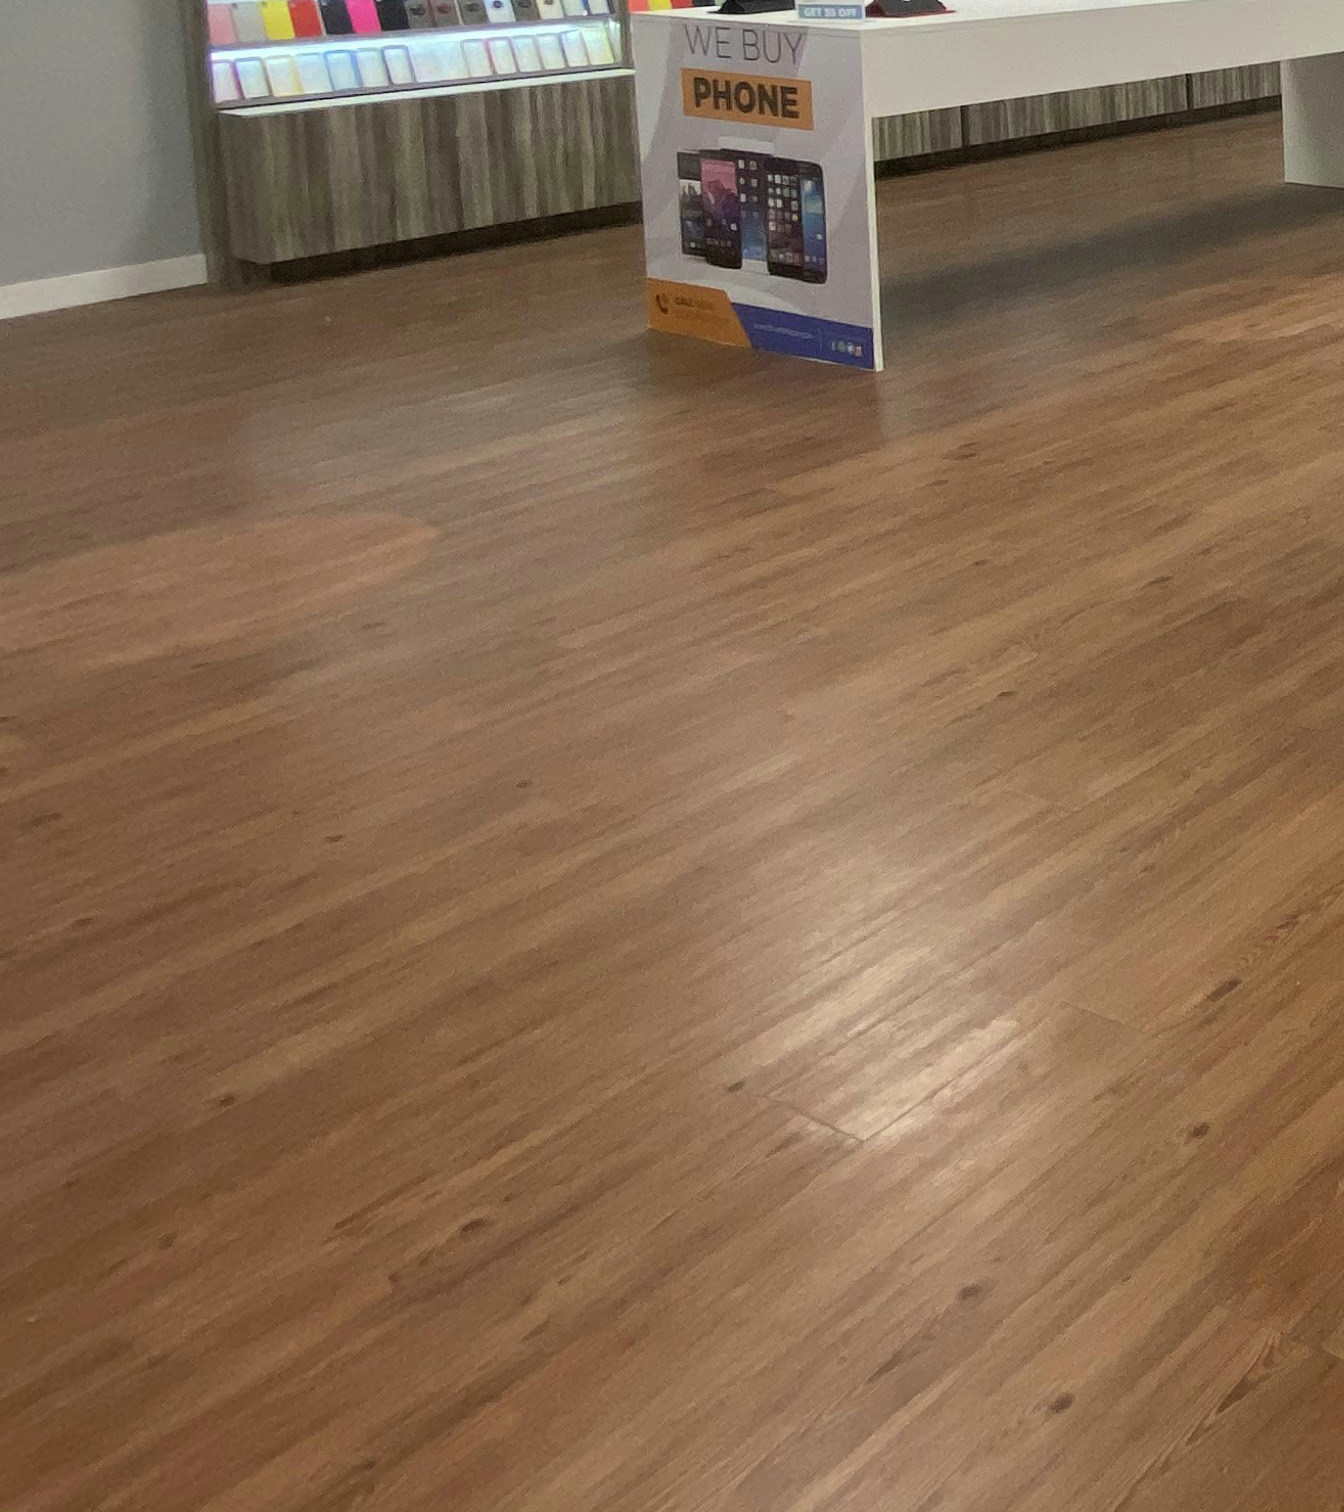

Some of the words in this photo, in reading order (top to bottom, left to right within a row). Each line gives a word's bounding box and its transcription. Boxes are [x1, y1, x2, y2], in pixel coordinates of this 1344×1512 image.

[684, 23, 733, 59] WE
[742, 28, 802, 65] BUY
[693, 76, 800, 119] PHONE
